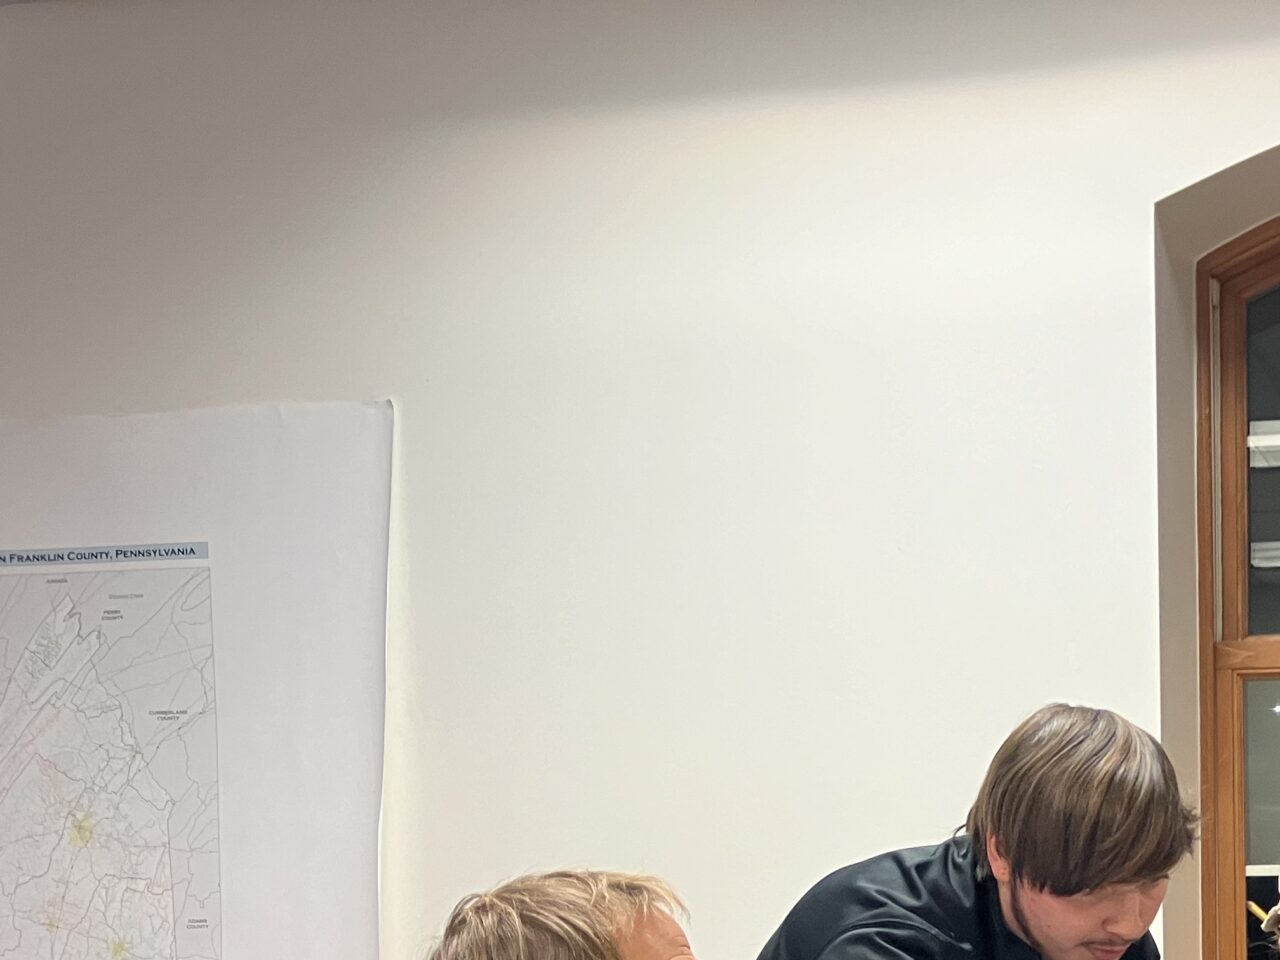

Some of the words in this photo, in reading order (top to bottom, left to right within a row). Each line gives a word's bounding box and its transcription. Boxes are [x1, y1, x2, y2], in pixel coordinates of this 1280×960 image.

[9, 553, 65, 563] FRANKLIN
[67, 549, 113, 561] COUNTY,
[115, 547, 196, 559] PENNSYLVANIA
